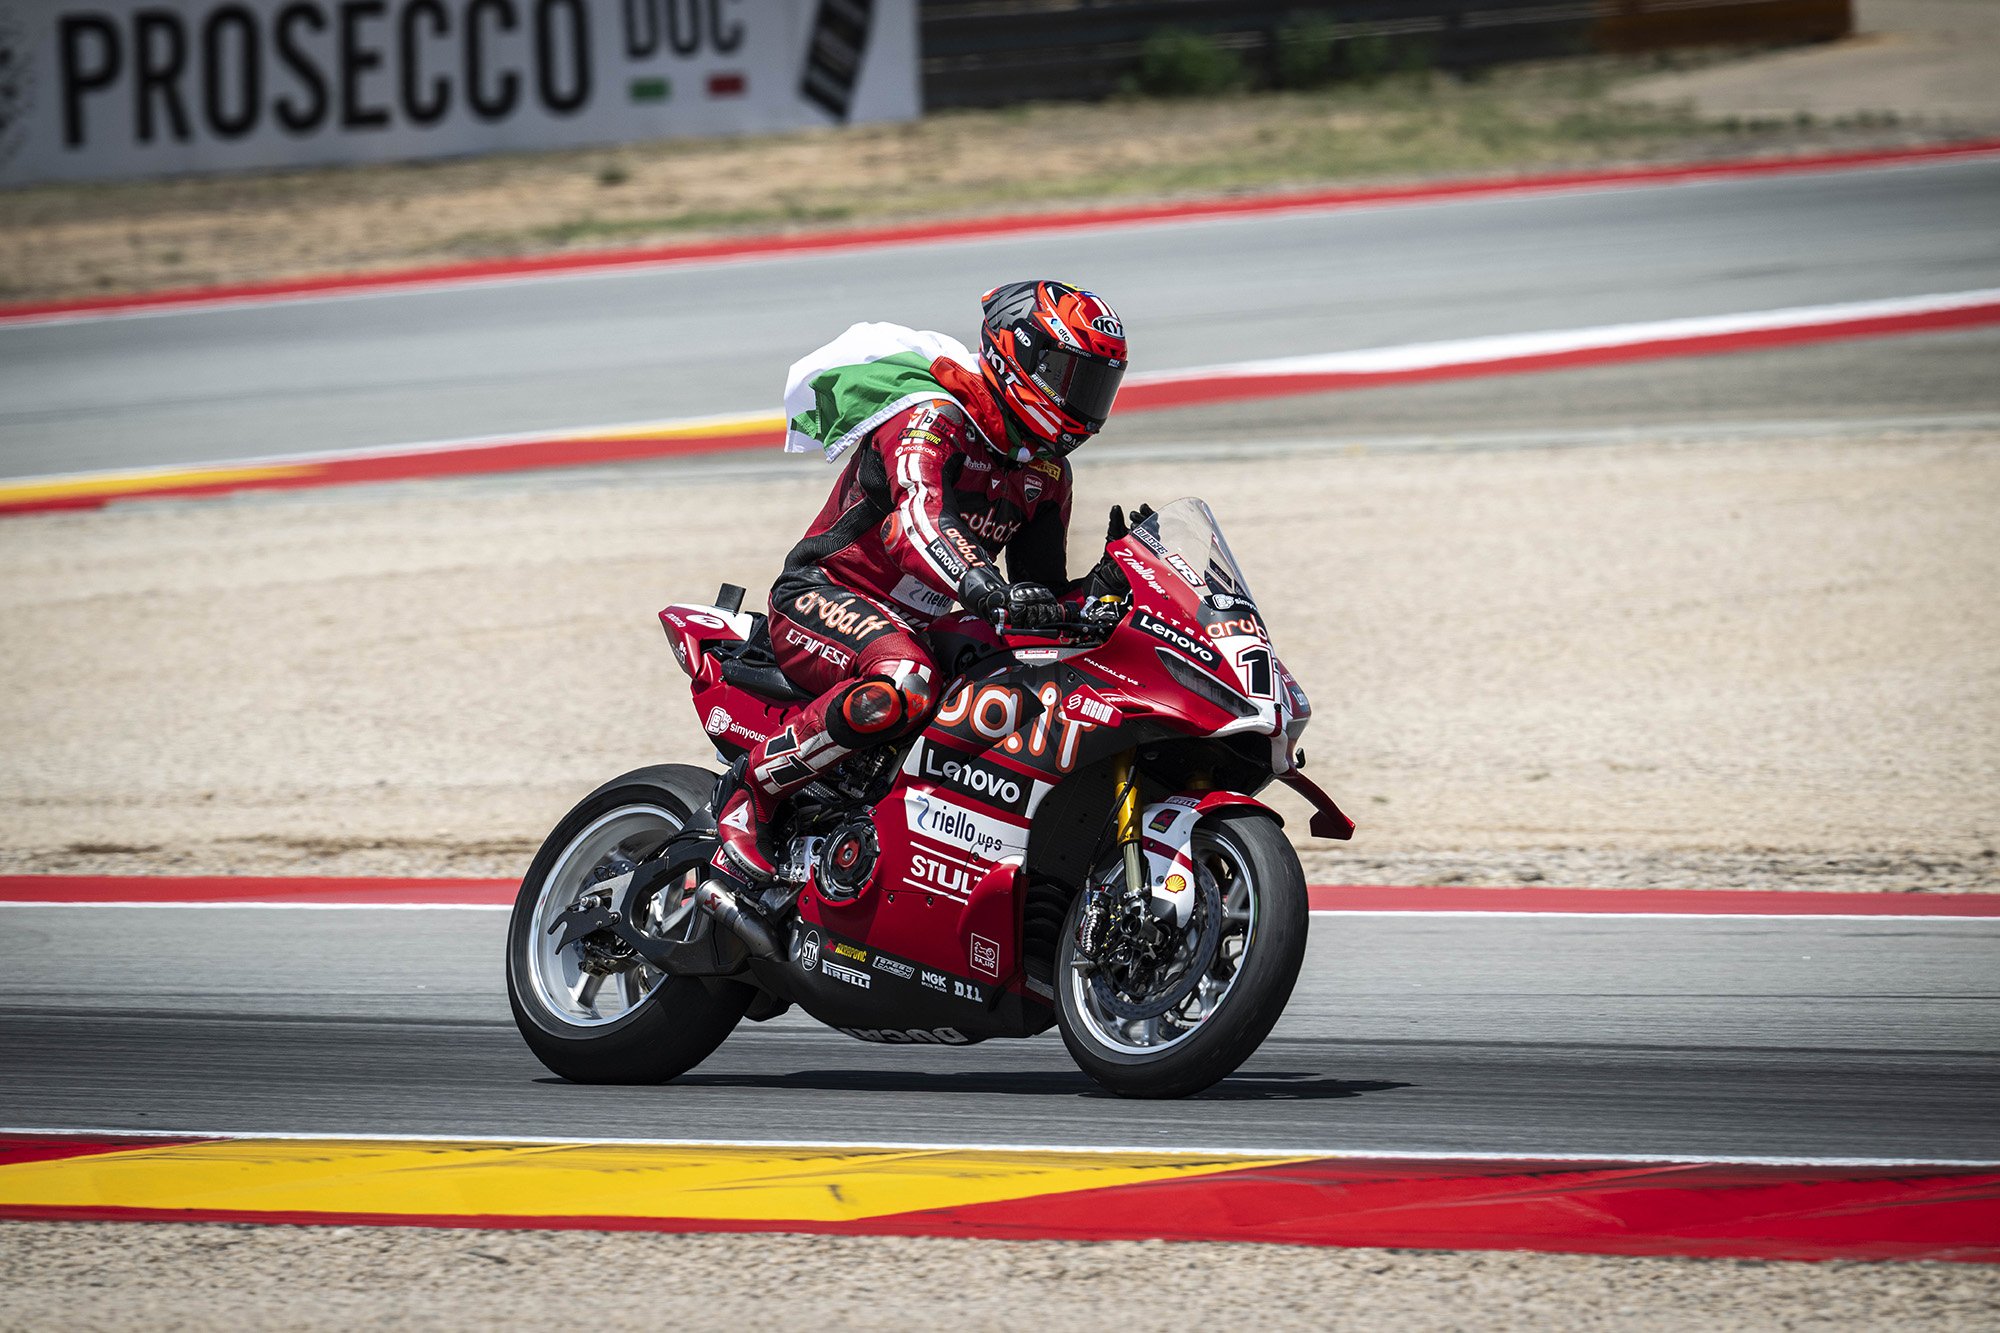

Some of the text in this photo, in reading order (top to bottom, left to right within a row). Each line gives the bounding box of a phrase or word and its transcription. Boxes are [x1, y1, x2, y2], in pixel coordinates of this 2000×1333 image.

[58, 0, 745, 148] PROSECCO DOC
[930, 540, 961, 576] Lenovo
[794, 590, 890, 641] aruba.it
[1137, 603, 1214, 648] ALTEN
[1139, 615, 1214, 662] Lenovo
[1083, 657, 1127, 681] PANIGALE
[729, 721, 769, 743] simyous
[926, 748, 1020, 804] Lenovo
[931, 805, 1004, 852] riello ups
[910, 854, 983, 895] STUL
[803, 941, 819, 962] STM
[822, 958, 872, 990] PIRELLI
[921, 970, 947, 988] NGK
